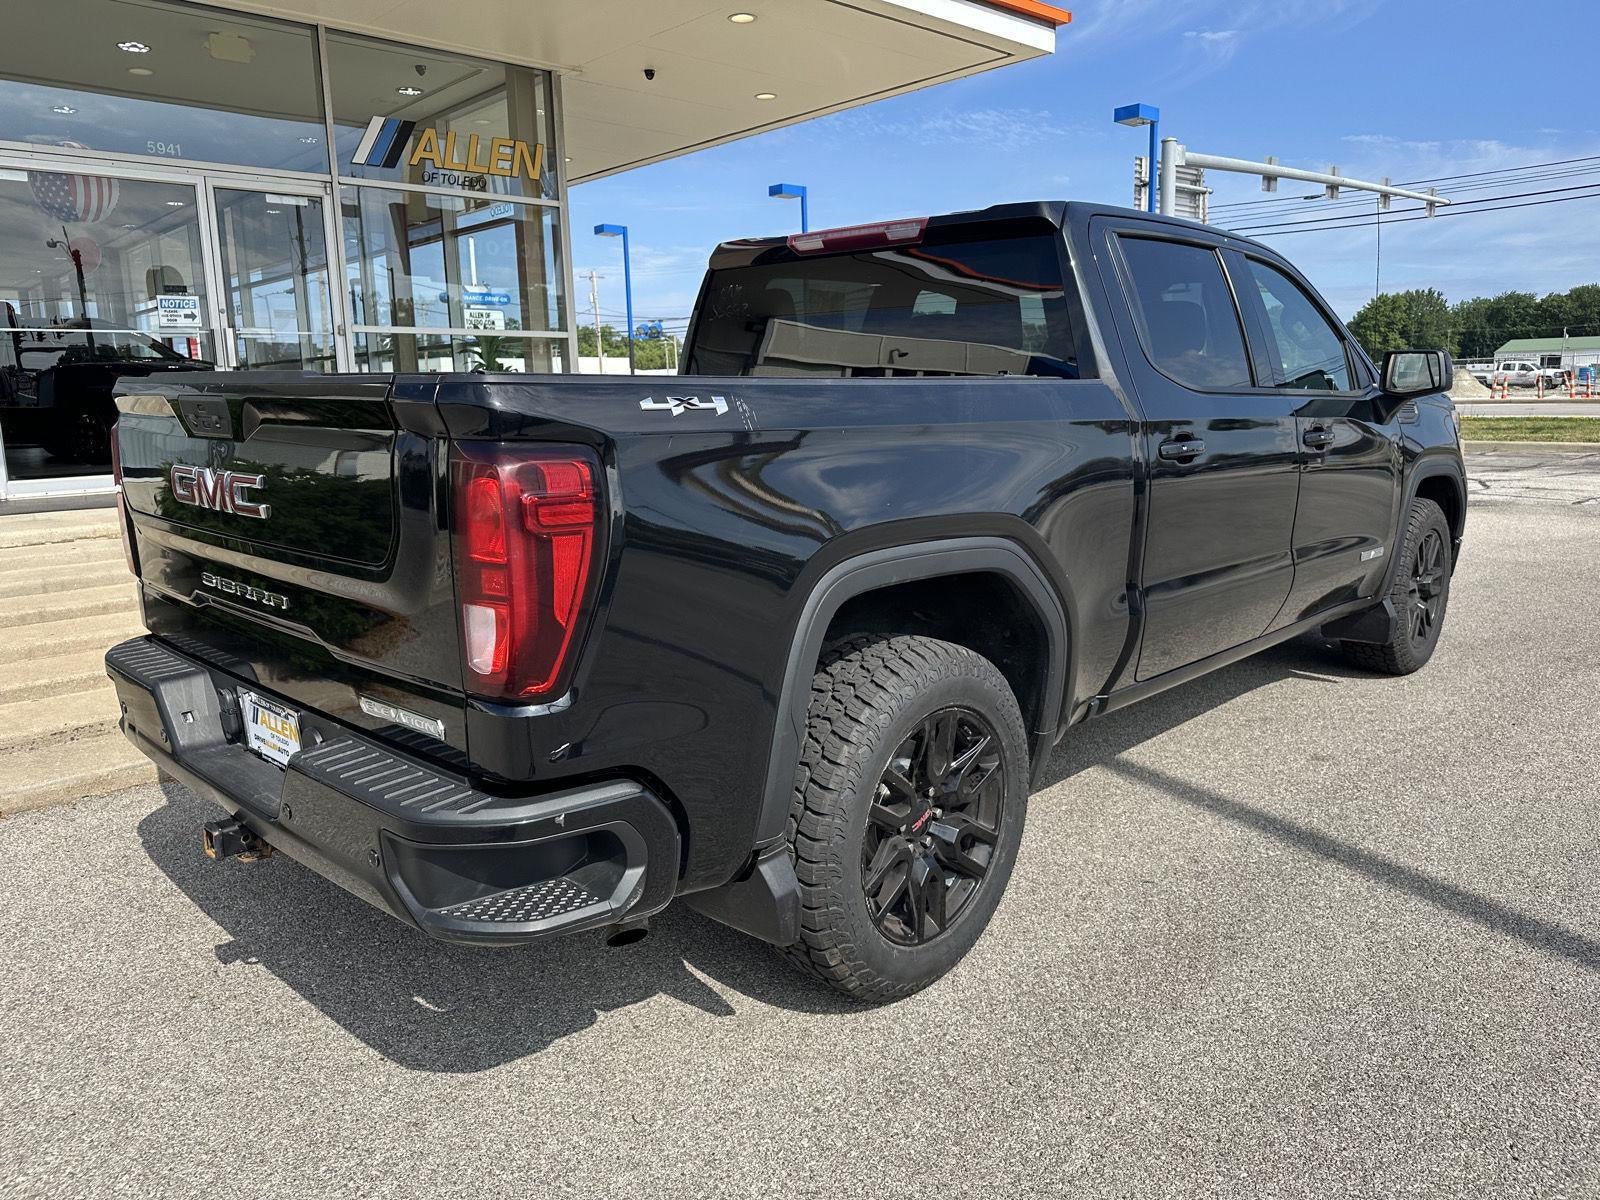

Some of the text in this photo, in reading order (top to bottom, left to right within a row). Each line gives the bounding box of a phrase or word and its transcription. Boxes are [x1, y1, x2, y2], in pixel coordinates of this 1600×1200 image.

[147, 140, 181, 157] 5941
[409, 127, 544, 181] ALLEN
[422, 171, 487, 189] OF TOLEDO
[162, 300, 195, 308] NOTICE
[171, 464, 272, 519] GMC
[201, 571, 290, 609] SIERRA
[260, 709, 299, 744] ALLEN
[364, 699, 439, 737] ELEVATION
